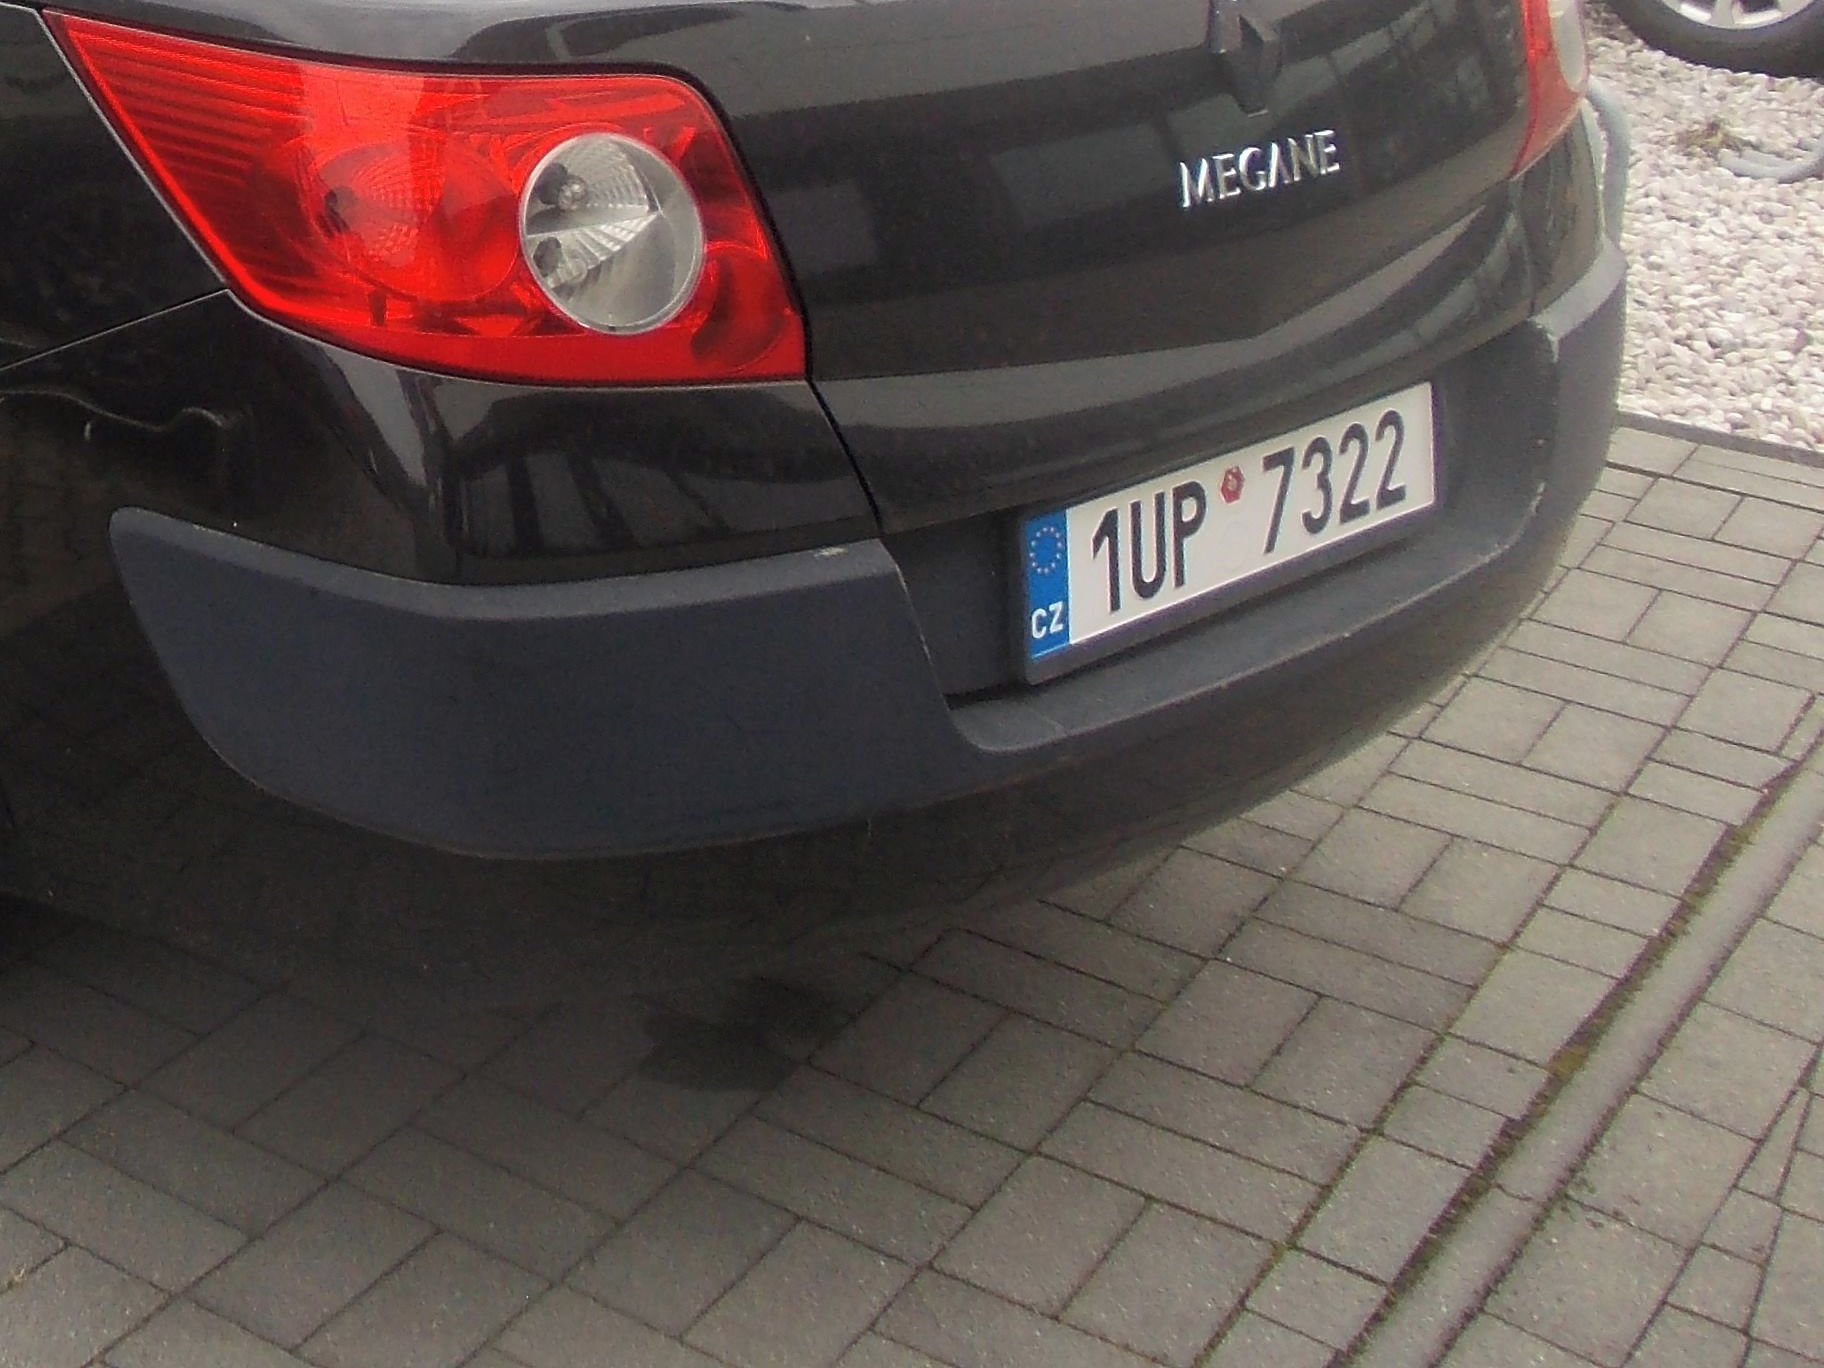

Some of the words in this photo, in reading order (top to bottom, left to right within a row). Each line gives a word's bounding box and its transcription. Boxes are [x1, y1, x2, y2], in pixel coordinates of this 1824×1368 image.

[1179, 130, 1340, 208] MEGANE
[1090, 480, 1209, 615] 1UP
[1261, 408, 1407, 555] 7322
[1030, 600, 1065, 639] CZ
